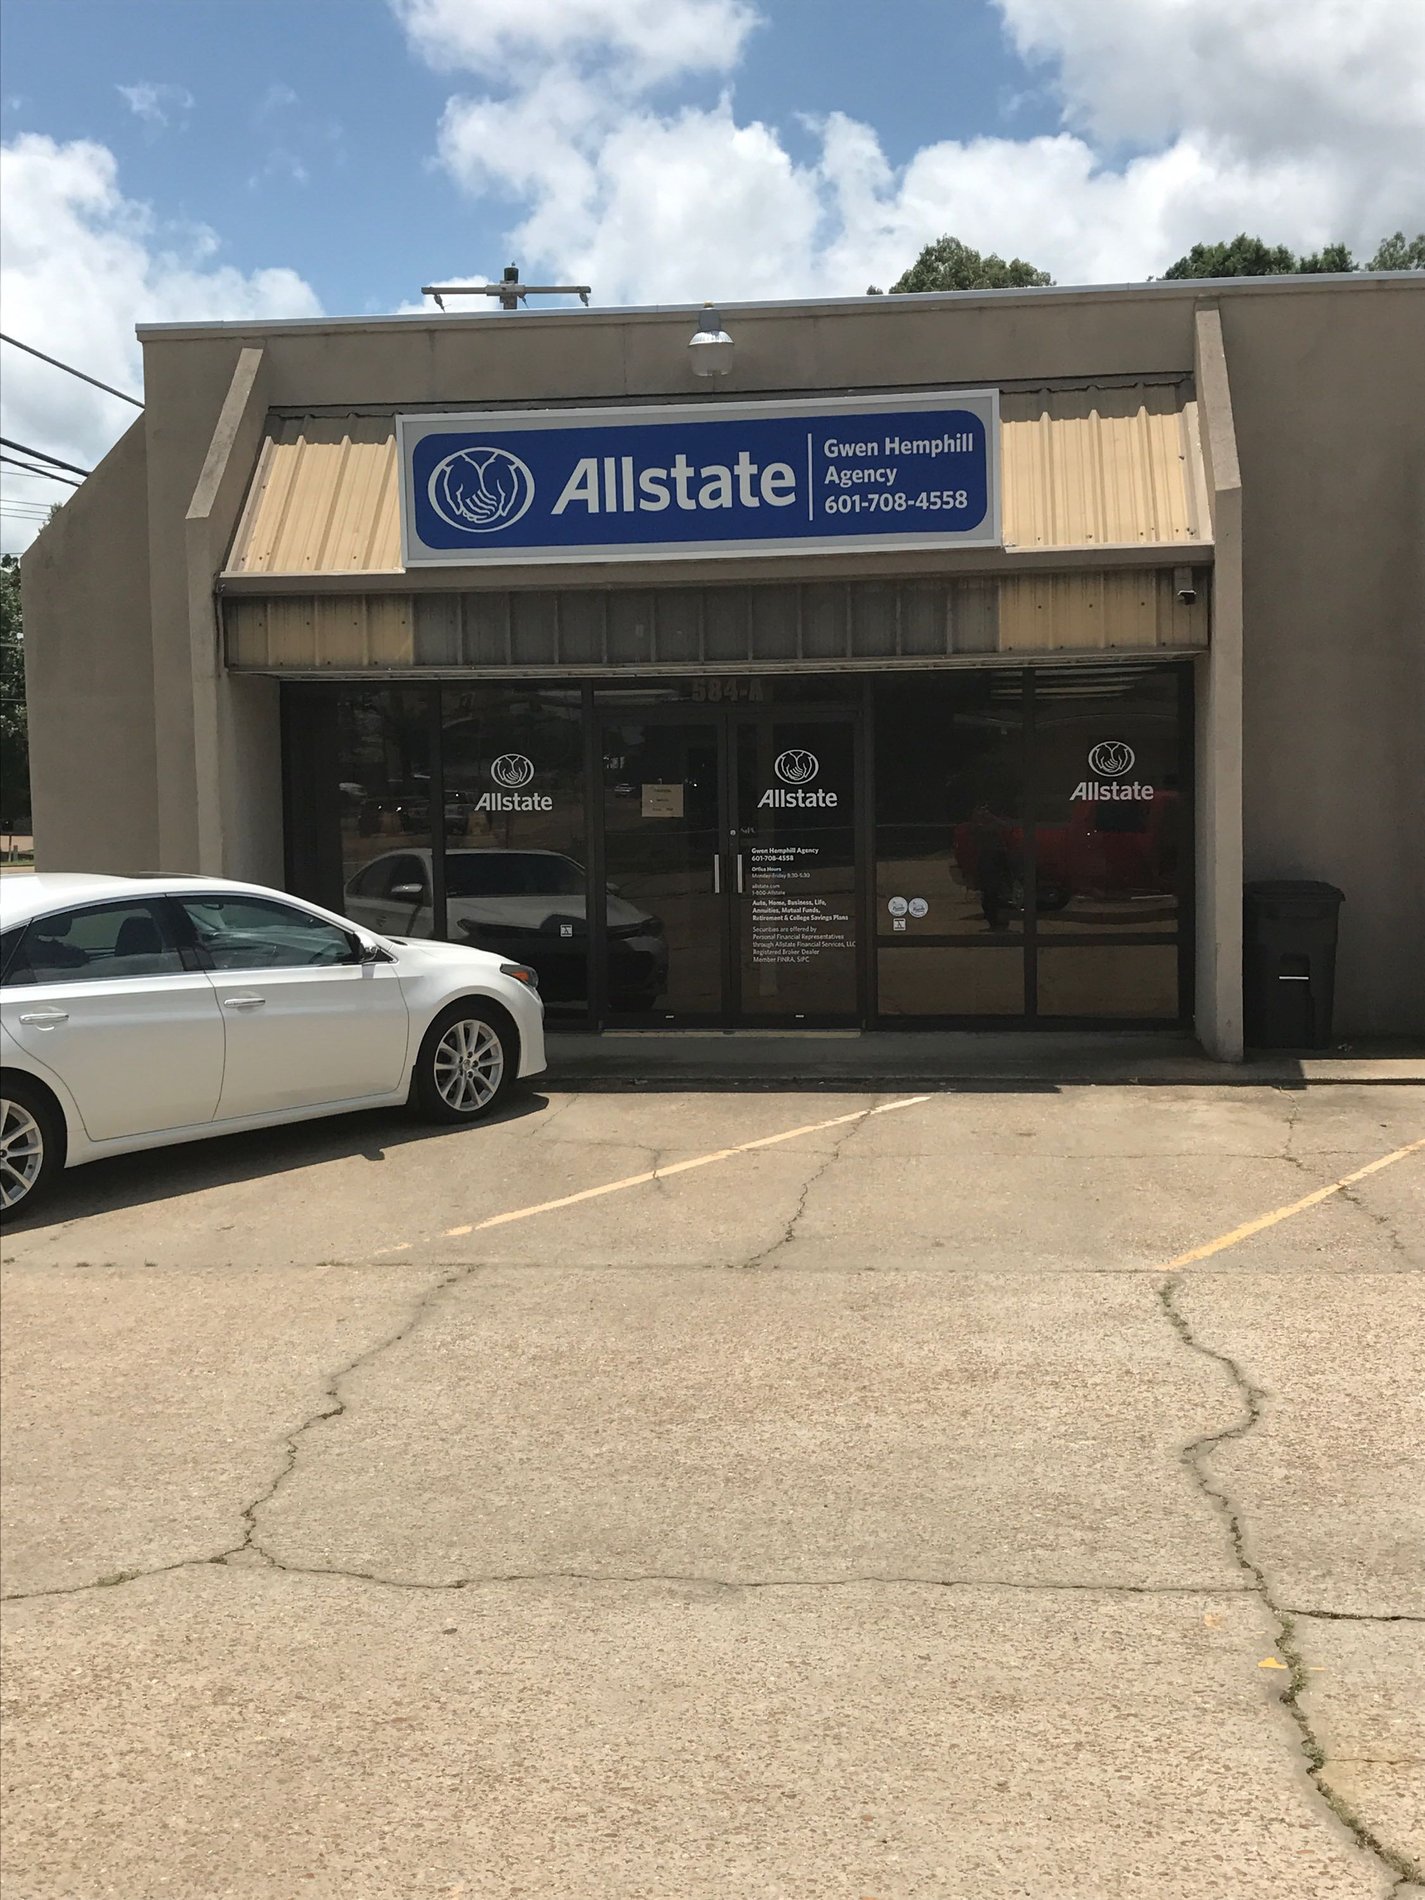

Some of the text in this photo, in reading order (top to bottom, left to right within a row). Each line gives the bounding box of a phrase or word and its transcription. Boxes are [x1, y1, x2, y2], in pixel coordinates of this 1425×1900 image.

[823, 433, 974, 458] Gwen Hemphill
[551, 451, 797, 515] Allstate
[824, 465, 898, 488] Agency
[824, 490, 968, 514] 601-708-4558
[691, 679, 763, 702] 584-A
[474, 792, 553, 811] Allstate
[757, 788, 838, 808] Allstate
[1069, 781, 1154, 801] Allstate
